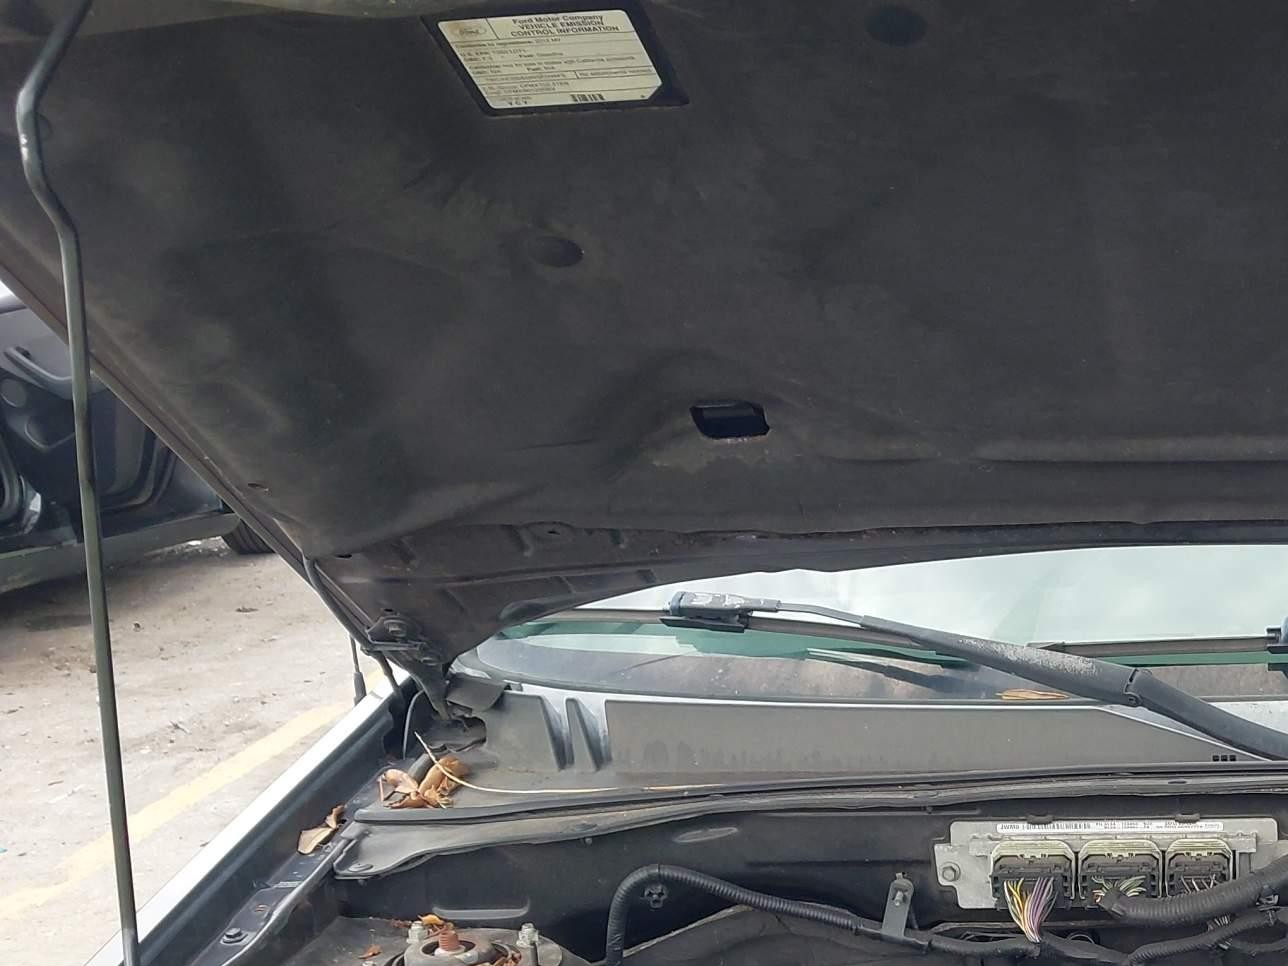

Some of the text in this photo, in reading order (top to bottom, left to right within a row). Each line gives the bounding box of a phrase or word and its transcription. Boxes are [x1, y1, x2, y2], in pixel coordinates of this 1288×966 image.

[562, 14, 604, 22] Company
[518, 20, 604, 30] VEHICLE EMISSION
[510, 26, 620, 37] CONTROL INFORMATION
